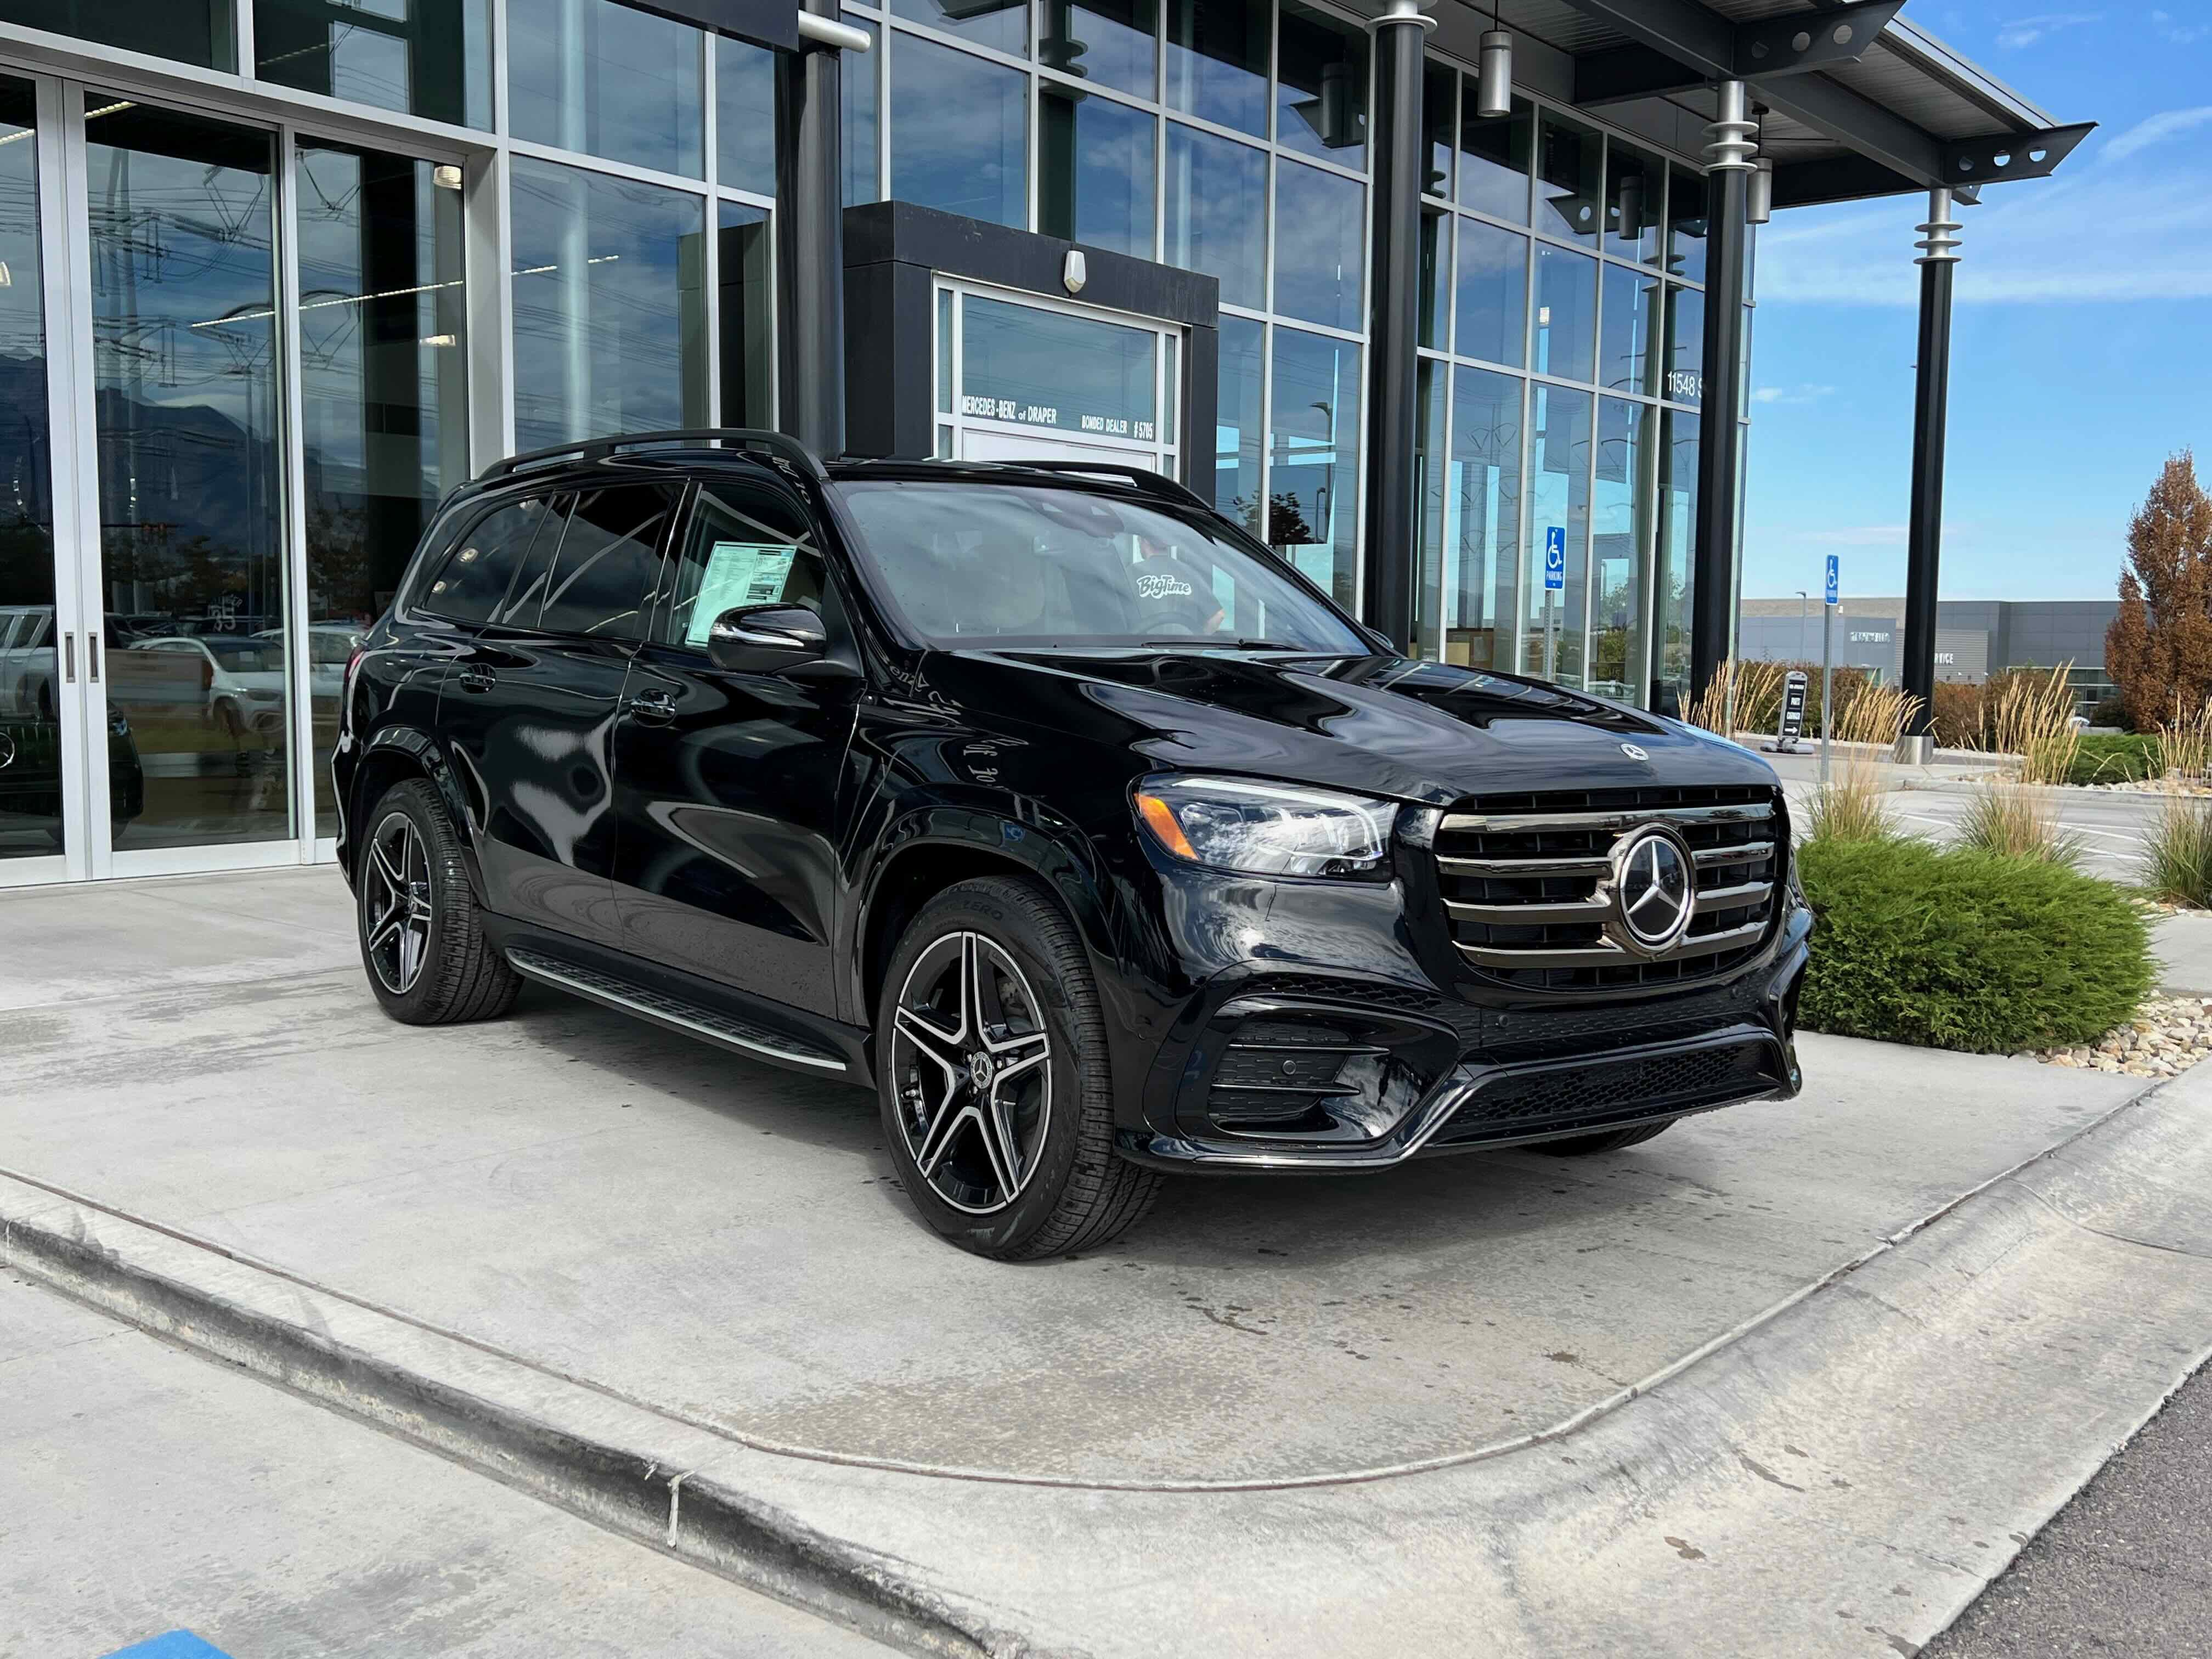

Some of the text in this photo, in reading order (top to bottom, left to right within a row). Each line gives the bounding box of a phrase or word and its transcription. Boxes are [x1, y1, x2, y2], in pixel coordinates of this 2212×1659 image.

[1668, 371, 1695, 397] 11548
[1018, 410, 1026, 421] of
[1028, 405, 1057, 424] DRAPER
[1081, 415, 1104, 431] BONDED
[1105, 419, 1127, 434] DEALER
[1546, 571, 1562, 581] PARKING
[964, 899, 1003, 921] ZERO
